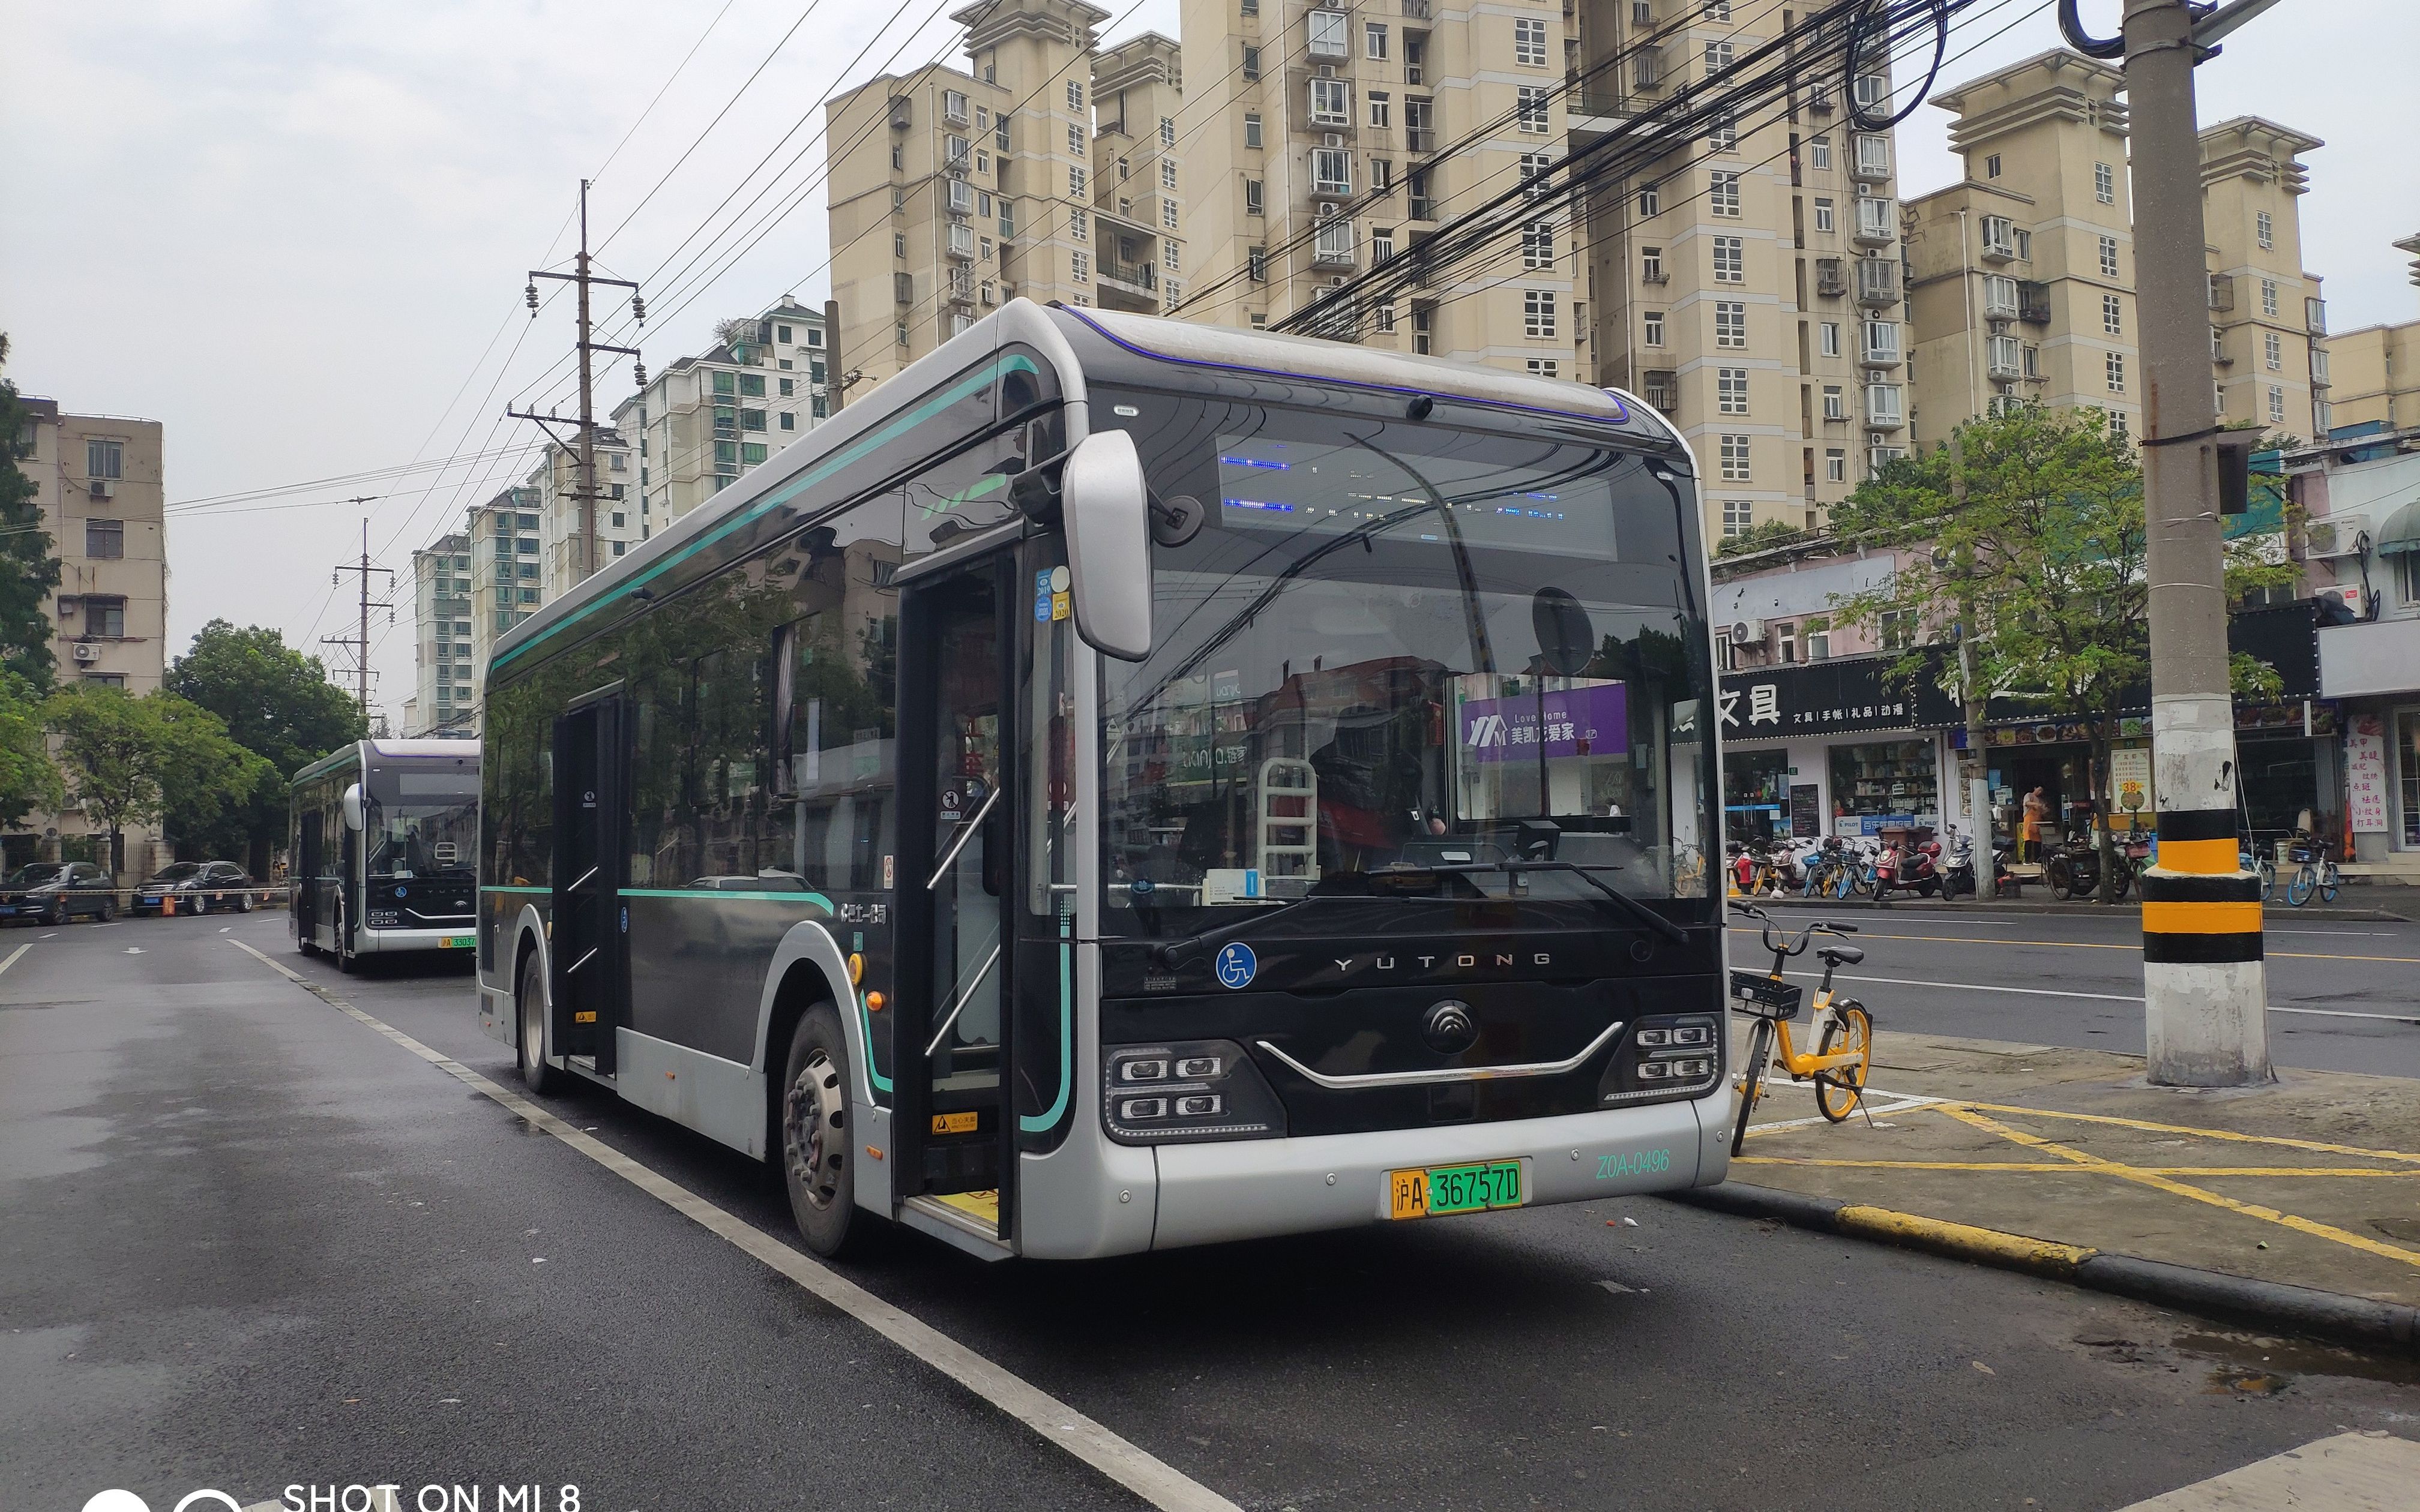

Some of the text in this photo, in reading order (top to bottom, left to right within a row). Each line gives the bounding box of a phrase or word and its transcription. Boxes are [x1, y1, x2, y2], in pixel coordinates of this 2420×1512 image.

[1055, 609, 1068, 619] 2020
[1720, 684, 1781, 727] 文具
[1515, 713, 1537, 724] Love
[1511, 722, 1575, 745] 美凯龙爱家
[2349, 738, 2368, 748] 美甲
[2123, 782, 2136, 792] 38
[2355, 807, 2381, 816] 小纹身
[2356, 818, 2383, 827] 打耳洞
[454, 937, 477, 946] 33037
[1334, 953, 1550, 972] YUTONG
[1396, 1168, 1519, 1211] 沪A 36757D
